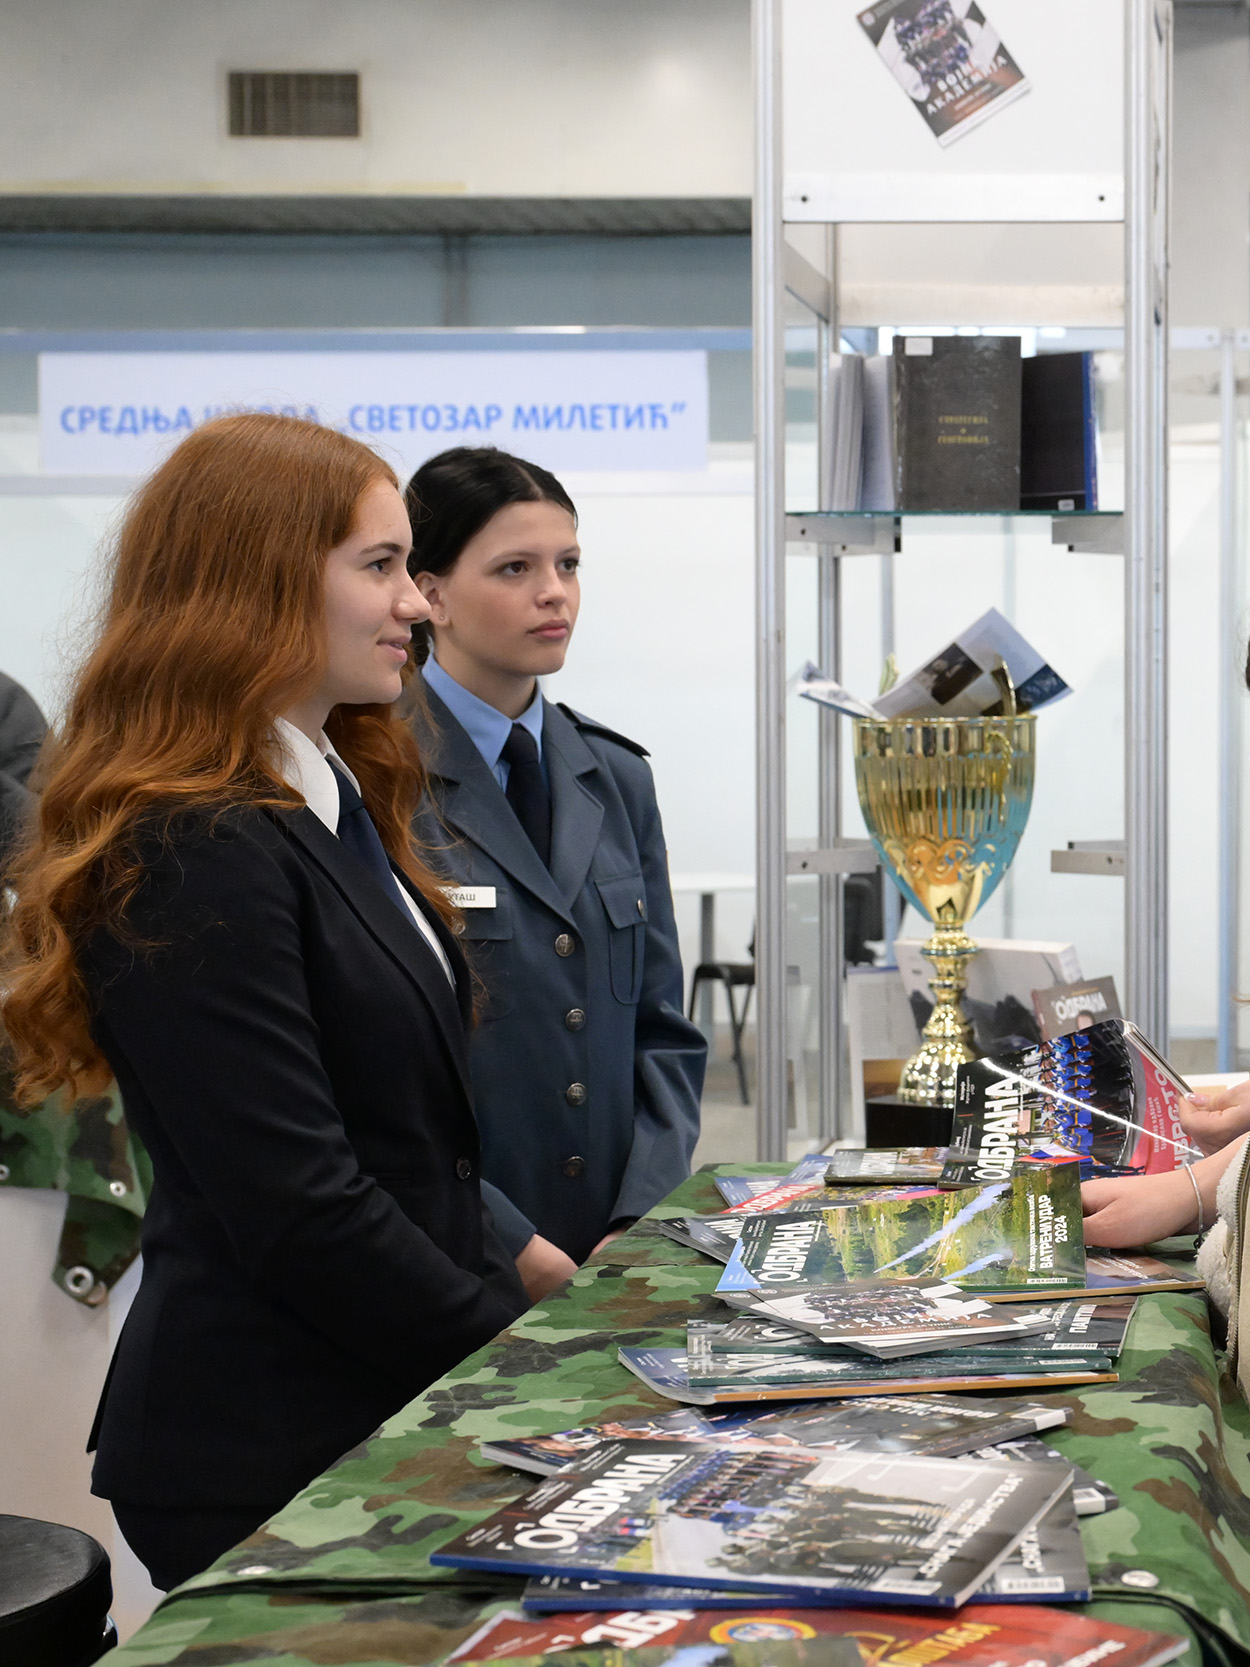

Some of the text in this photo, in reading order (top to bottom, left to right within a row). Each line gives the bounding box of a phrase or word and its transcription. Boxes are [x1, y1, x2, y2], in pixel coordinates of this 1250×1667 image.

[60, 405, 193, 437] СРЕДЊА
[1052, 990, 1108, 1021] ОДБРАНА
[973, 1075, 1019, 1181] ОДБРАНА
[757, 1220, 817, 1282] ОДБРАНА
[1053, 1214, 1068, 1244] 2024
[513, 1453, 688, 1550] ОДБРАНА
